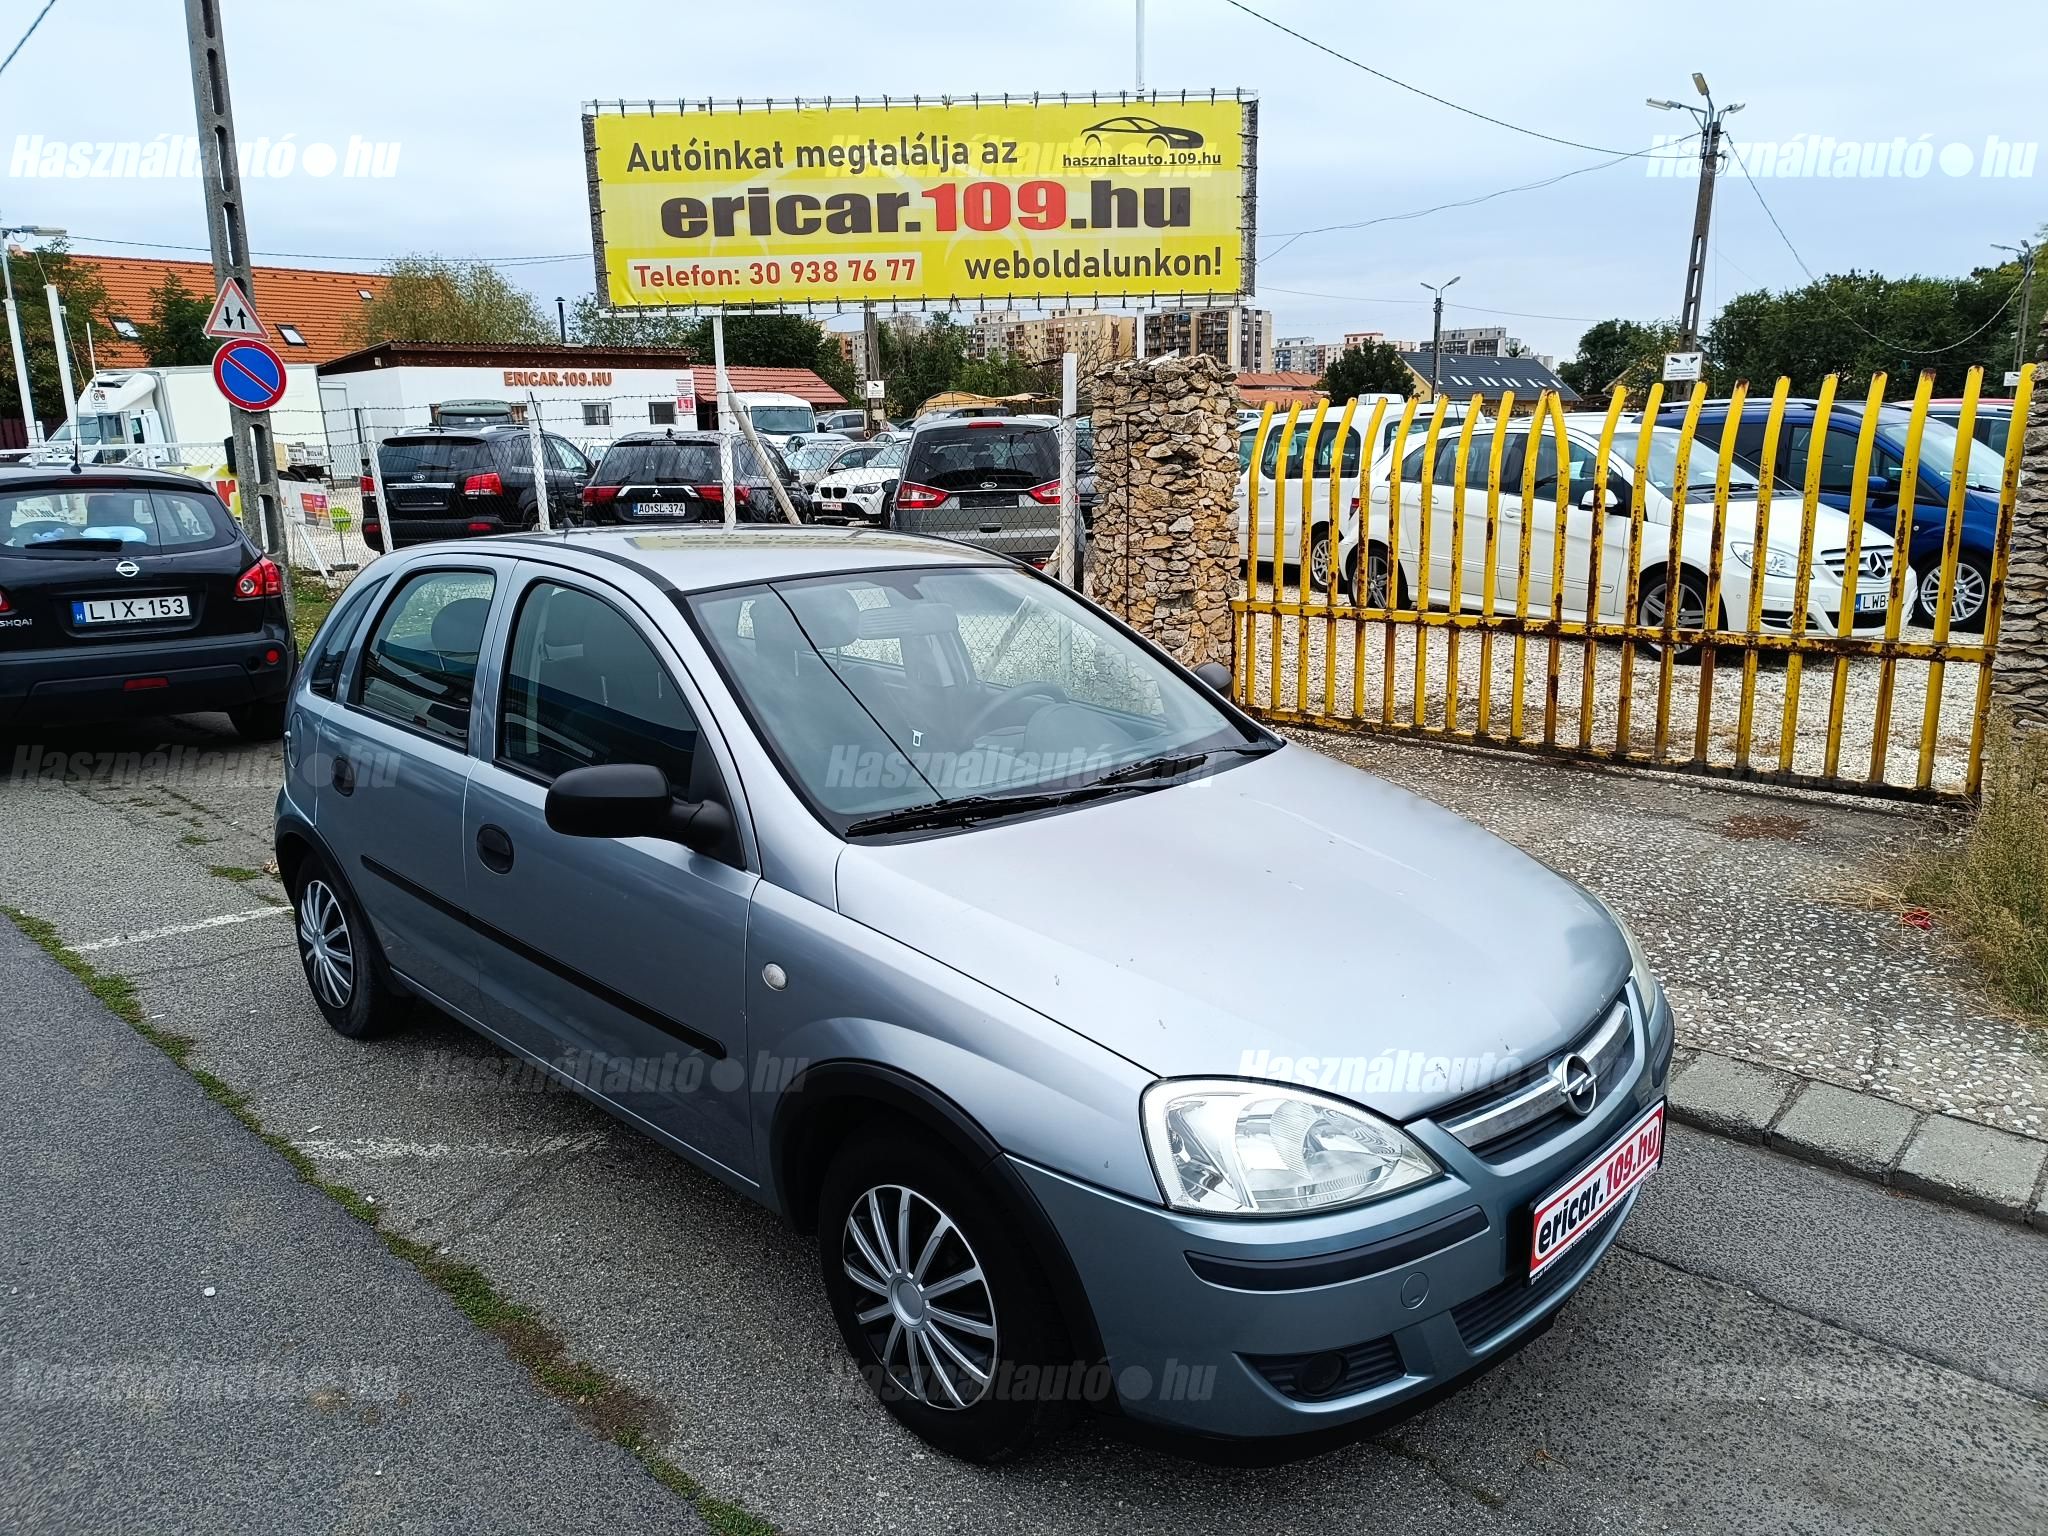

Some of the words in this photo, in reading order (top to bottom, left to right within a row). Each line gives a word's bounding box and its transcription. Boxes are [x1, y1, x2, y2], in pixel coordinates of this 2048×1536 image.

[626, 137, 783, 172] Autóinkat
[796, 131, 969, 174] megtalálja
[981, 141, 1018, 164] az
[1063, 152, 1221, 167] hasznaltauto.109.hu
[660, 179, 1191, 239] ericar.109.hu
[633, 264, 740, 287] Telefon:
[749, 262, 780, 284] 30
[790, 260, 838, 283] 938
[848, 259, 877, 281] 76
[886, 258, 915, 280] 77
[964, 246, 1221, 280] weboldalunkon!
[503, 371, 612, 386] ERICAR.109.HU
[89, 598, 185, 621] LIX-153
[1538, 1123, 1657, 1254] ericar.109.hu
